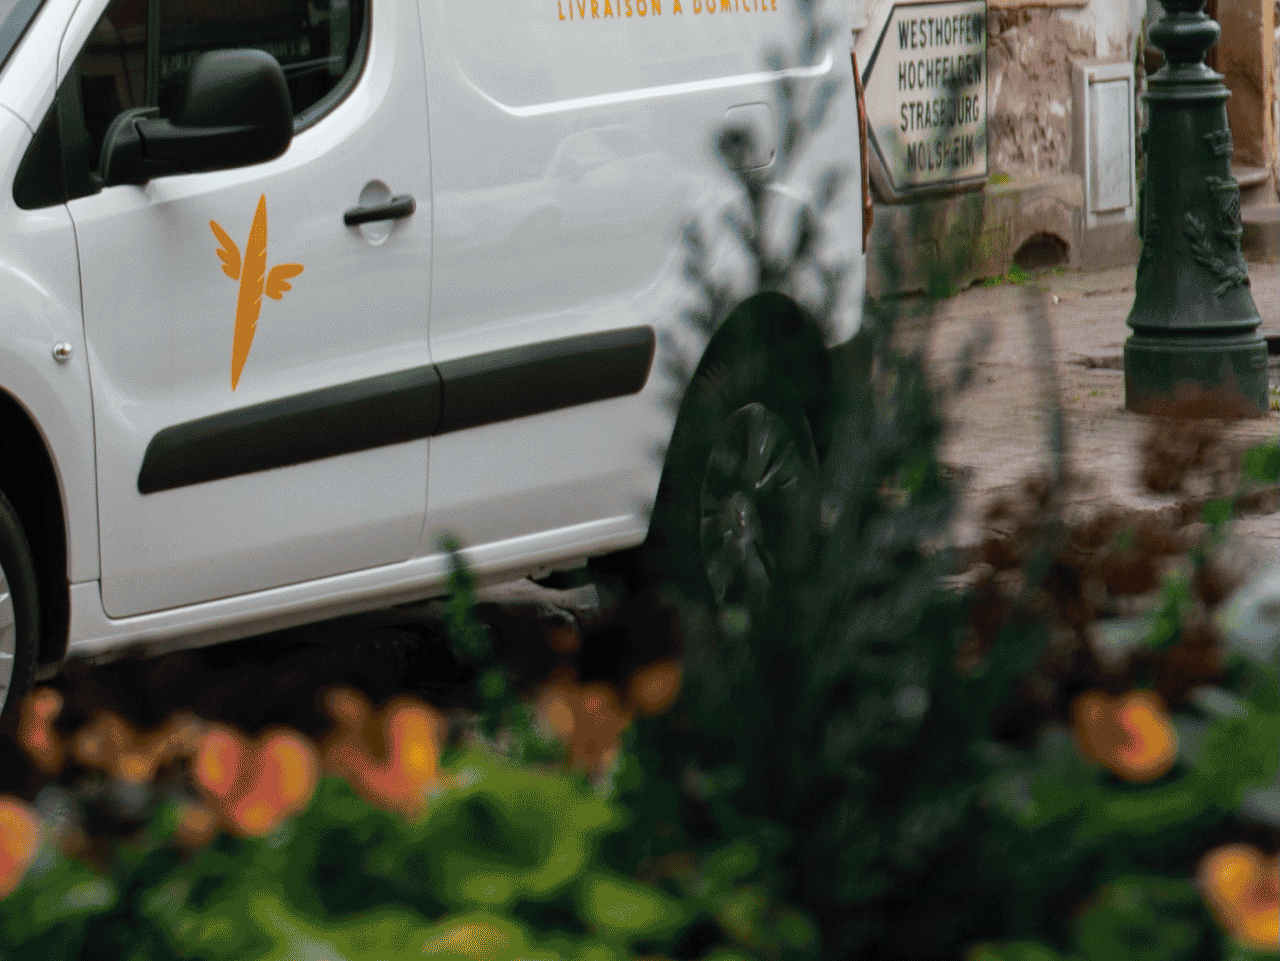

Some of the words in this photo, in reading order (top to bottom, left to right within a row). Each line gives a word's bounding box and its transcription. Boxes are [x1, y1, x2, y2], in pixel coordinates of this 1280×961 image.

[897, 11, 983, 50] WESTHOFFEN
[897, 52, 982, 91] HOCHFELDEN
[905, 134, 976, 174] MOLSHEIM
